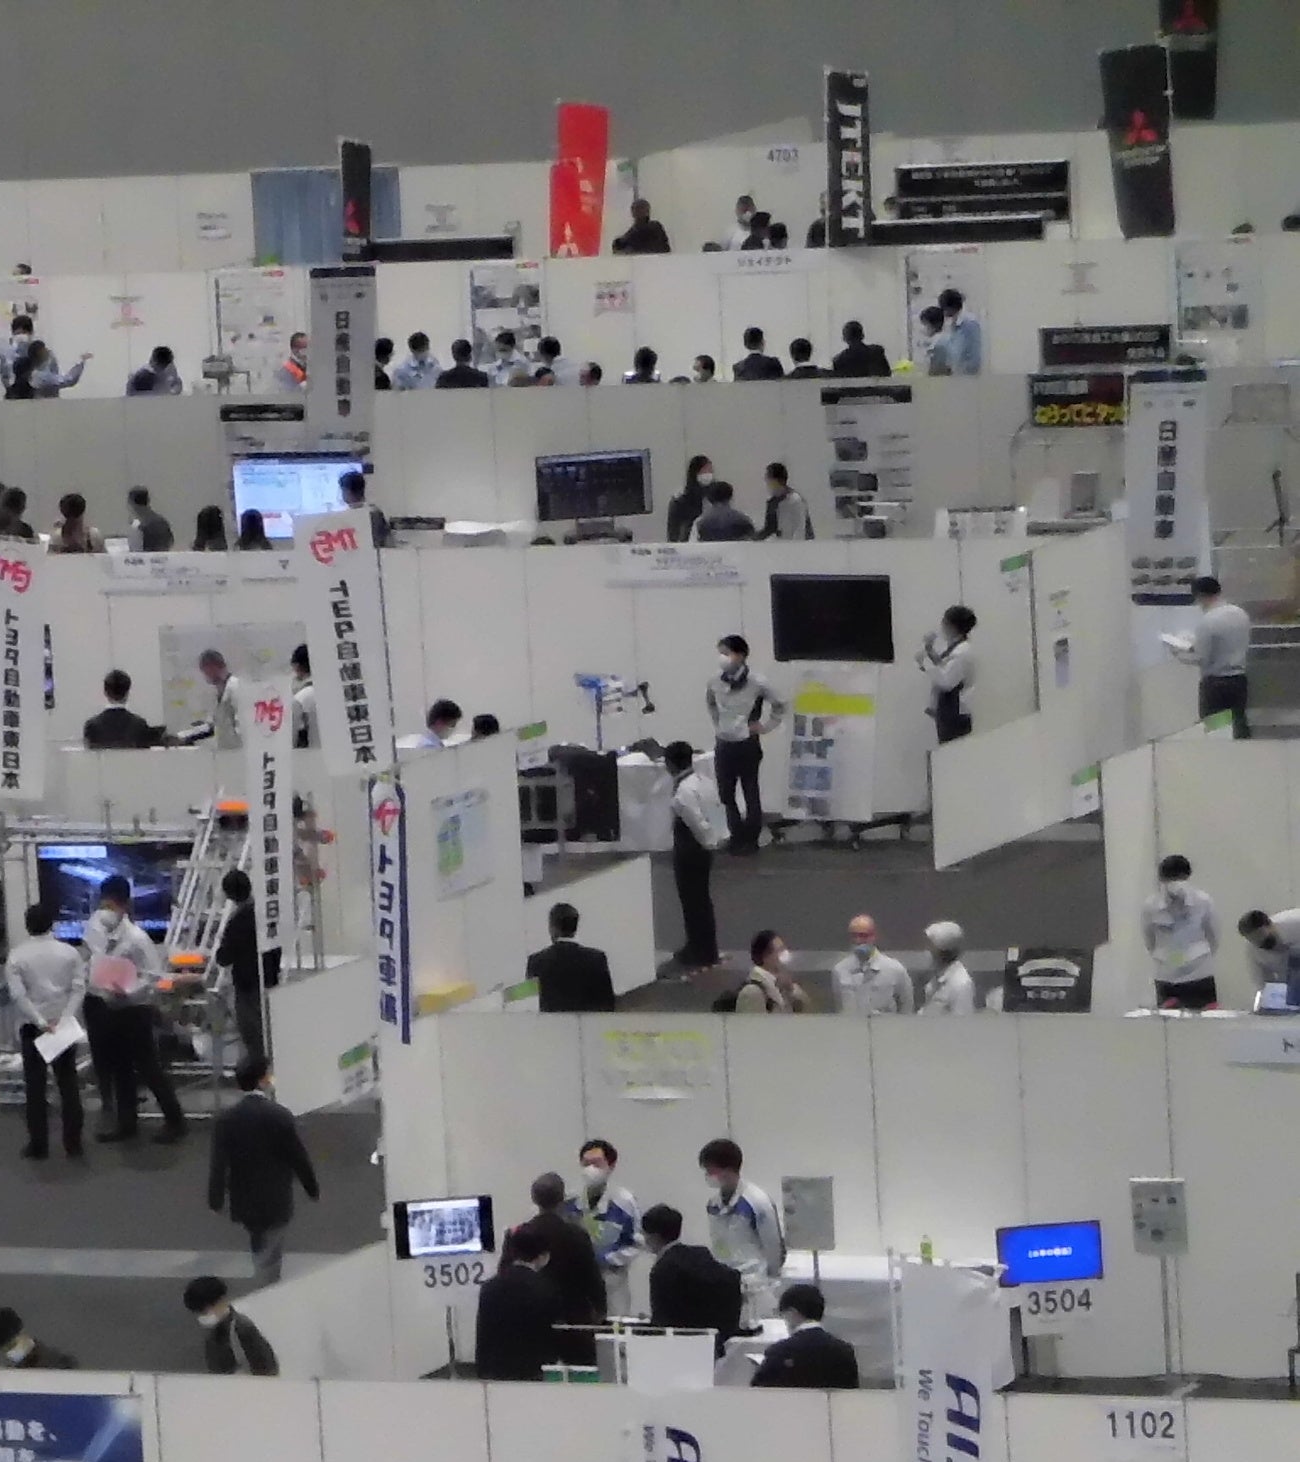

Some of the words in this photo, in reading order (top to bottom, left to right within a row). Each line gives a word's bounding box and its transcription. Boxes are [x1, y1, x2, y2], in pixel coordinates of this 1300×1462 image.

[423, 1262, 487, 1291] 3502
[1027, 1289, 1093, 1315] 3504
[916, 1368, 933, 1401] We
[1107, 1408, 1176, 1440] 1102
